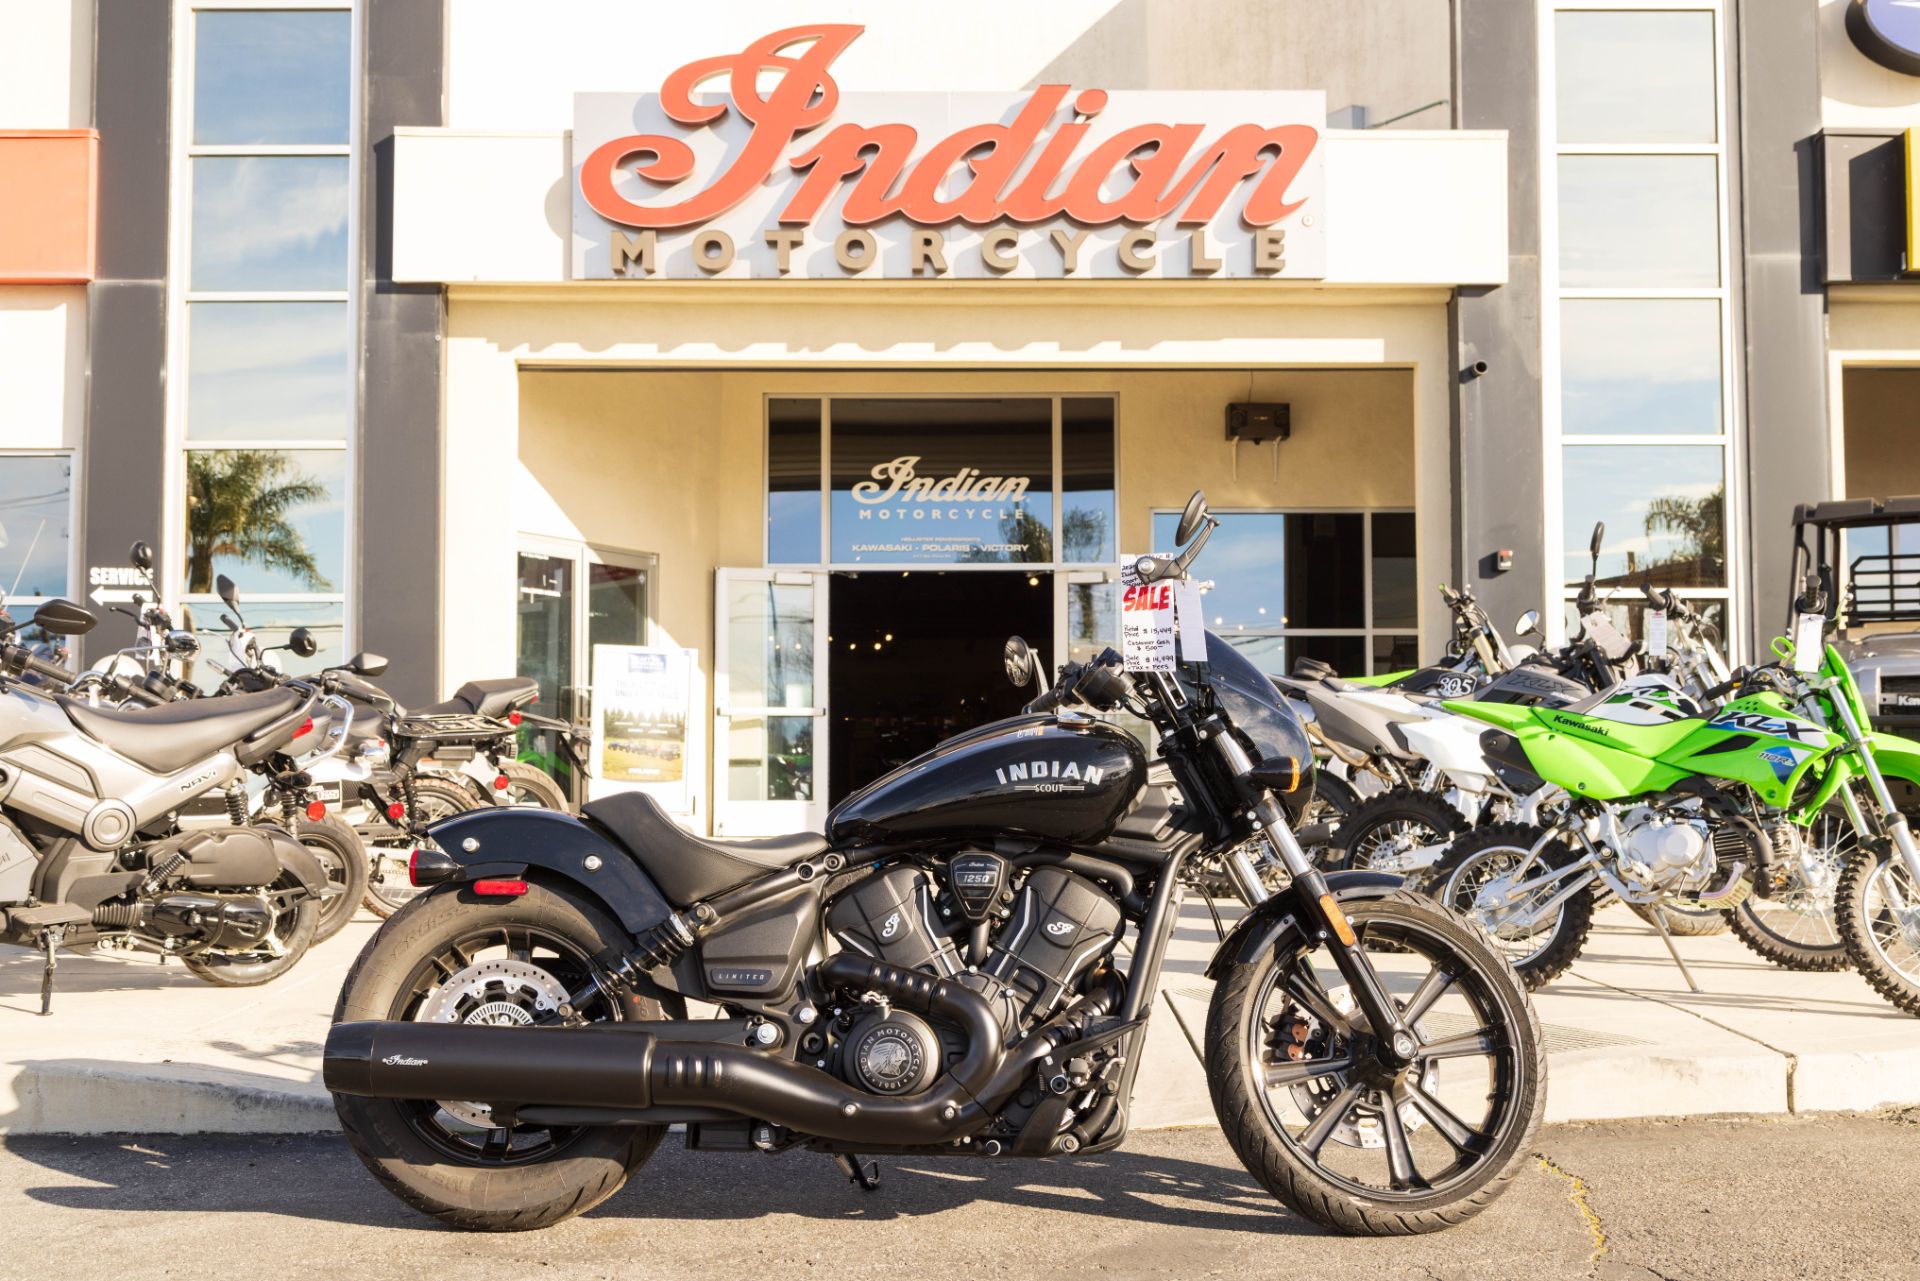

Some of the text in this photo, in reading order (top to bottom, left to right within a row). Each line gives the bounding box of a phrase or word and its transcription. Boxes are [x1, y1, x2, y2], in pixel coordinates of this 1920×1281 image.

[580, 24, 1319, 228] Indian
[611, 229, 1286, 275] MOTORCYCLE
[851, 455, 1030, 505] Indian
[859, 508, 1025, 520] MOTORCYCLE
[852, 543, 913, 552] KAWASAKI
[922, 543, 971, 552] POLARIS
[980, 543, 1030, 552] VICTORY
[90, 566, 154, 585] SERVICE
[1123, 585, 1171, 611] SALE
[1440, 677, 1473, 695] 805
[1506, 673, 1584, 693] KLX
[1553, 715, 1610, 737] Kawasaki
[1711, 710, 1824, 742] KLX
[180, 771, 217, 791] NAVI
[995, 760, 1104, 786] INDIAN
[1034, 783, 1064, 793] SCOUT
[963, 874, 990, 883] 1250
[718, 973, 765, 981] LIMITED
[385, 1054, 424, 1066] Indian
[861, 1027, 920, 1078] INDIAN MOTORCYCLE
